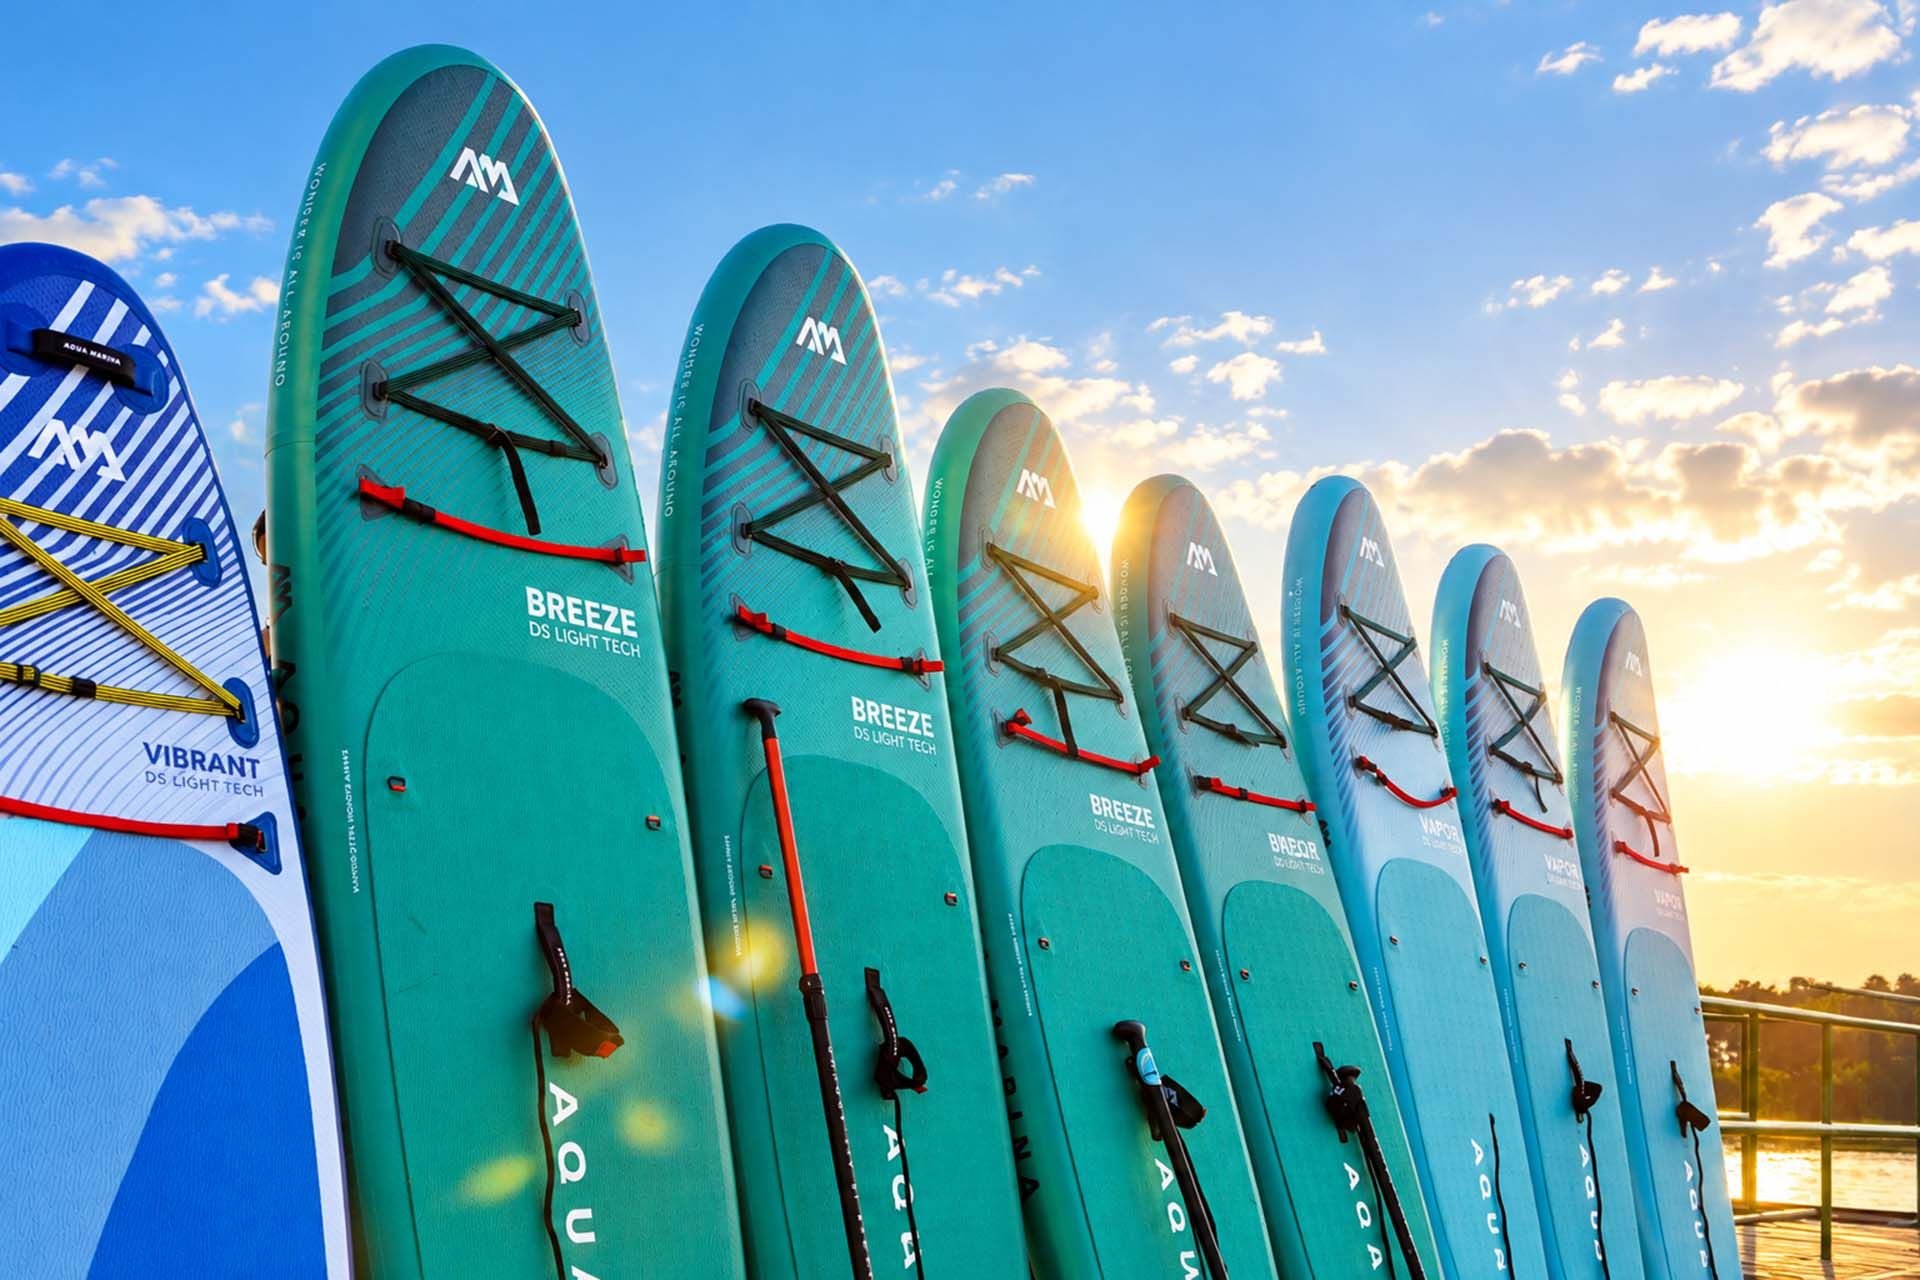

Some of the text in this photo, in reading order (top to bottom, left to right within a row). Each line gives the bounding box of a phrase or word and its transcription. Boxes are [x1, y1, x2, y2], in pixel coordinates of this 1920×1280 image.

[525, 586, 639, 638] BREEZE
[529, 621, 641, 658] DS LIGHT TECH
[851, 696, 935, 738] BREEZE
[853, 726, 937, 756] DS LIGHT TECH
[142, 742, 260, 779] VIBRANT
[145, 771, 264, 798] DS LIGHT TECH
[1089, 793, 1155, 829] BREEZE
[1418, 813, 1459, 842] VAPOR
[1094, 819, 1160, 845] DS LIGHT TECH
